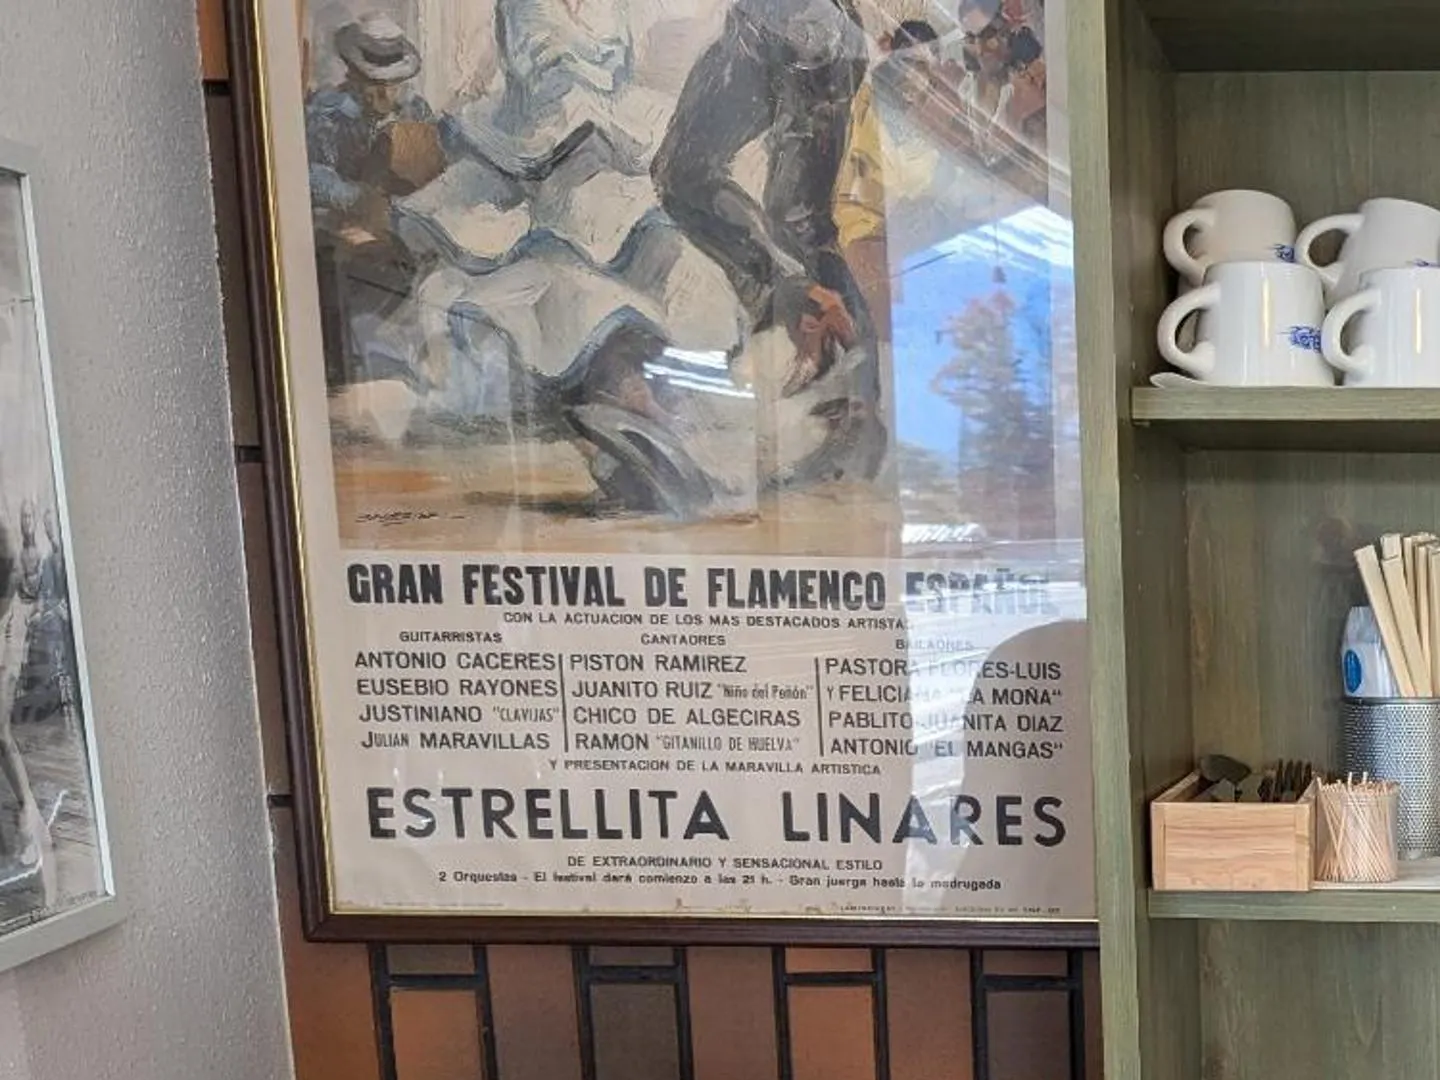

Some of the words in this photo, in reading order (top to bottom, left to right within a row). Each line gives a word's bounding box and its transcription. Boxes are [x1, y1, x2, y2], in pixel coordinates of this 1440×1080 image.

[347, 563, 444, 605] GRAN
[462, 563, 626, 607] FESTIVAL
[643, 566, 689, 608] DE
[706, 567, 886, 612] FLAMENCO
[905, 567, 1060, 615] ESPAÑ
[503, 611, 534, 624] CON
[538, 611, 557, 624] LA
[563, 611, 643, 625] ACTUACION
[649, 613, 669, 625] DE
[675, 613, 704, 626] LOS
[708, 614, 741, 627] MAS
[746, 615, 841, 629] DESTACADOS
[847, 617, 910, 629] ARTISTA
[398, 631, 503, 644] GUITARRISTAS
[640, 632, 727, 646] CANTAORES
[354, 650, 447, 670] ANTONIO
[456, 651, 556, 671] CACERES
[569, 653, 644, 672] PISTON
[654, 654, 748, 673] RAMIREZ
[356, 677, 450, 696] EUSEBIO
[459, 678, 559, 698] RAYONES
[571, 680, 659, 698] JUANITO
[665, 680, 713, 700] RUIZ
[839, 685, 940, 704] FELICIA
[358, 703, 483, 723] JUSTINIANO
[573, 705, 637, 725] CHICO
[647, 707, 676, 725] DE
[685, 707, 801, 728] ALGECIRAS
[1016, 714, 1065, 733] DIAZ
[419, 731, 550, 750] MARAVILLAS
[575, 732, 650, 751] RAMON
[728, 736, 743, 752] DE
[830, 737, 918, 756] ANTONIO
[967, 740, 1064, 760] MANGAS"
[548, 759, 558, 771] Y
[563, 759, 670, 771] PRESENTACION
[676, 759, 695, 771] DE
[701, 760, 720, 772] LA
[724, 761, 804, 773] MARAVILLA
[811, 763, 881, 776] ARTISTICA
[366, 786, 730, 841] ESTRELLITA
[782, 790, 1066, 848] LINARES
[567, 855, 586, 867] DE
[592, 855, 713, 869] EXTRAORDINARIO
[717, 856, 727, 869] Y
[732, 857, 830, 871] SENSACIONAL
[835, 859, 883, 871] ESTILO
[438, 871, 447, 883] 2
